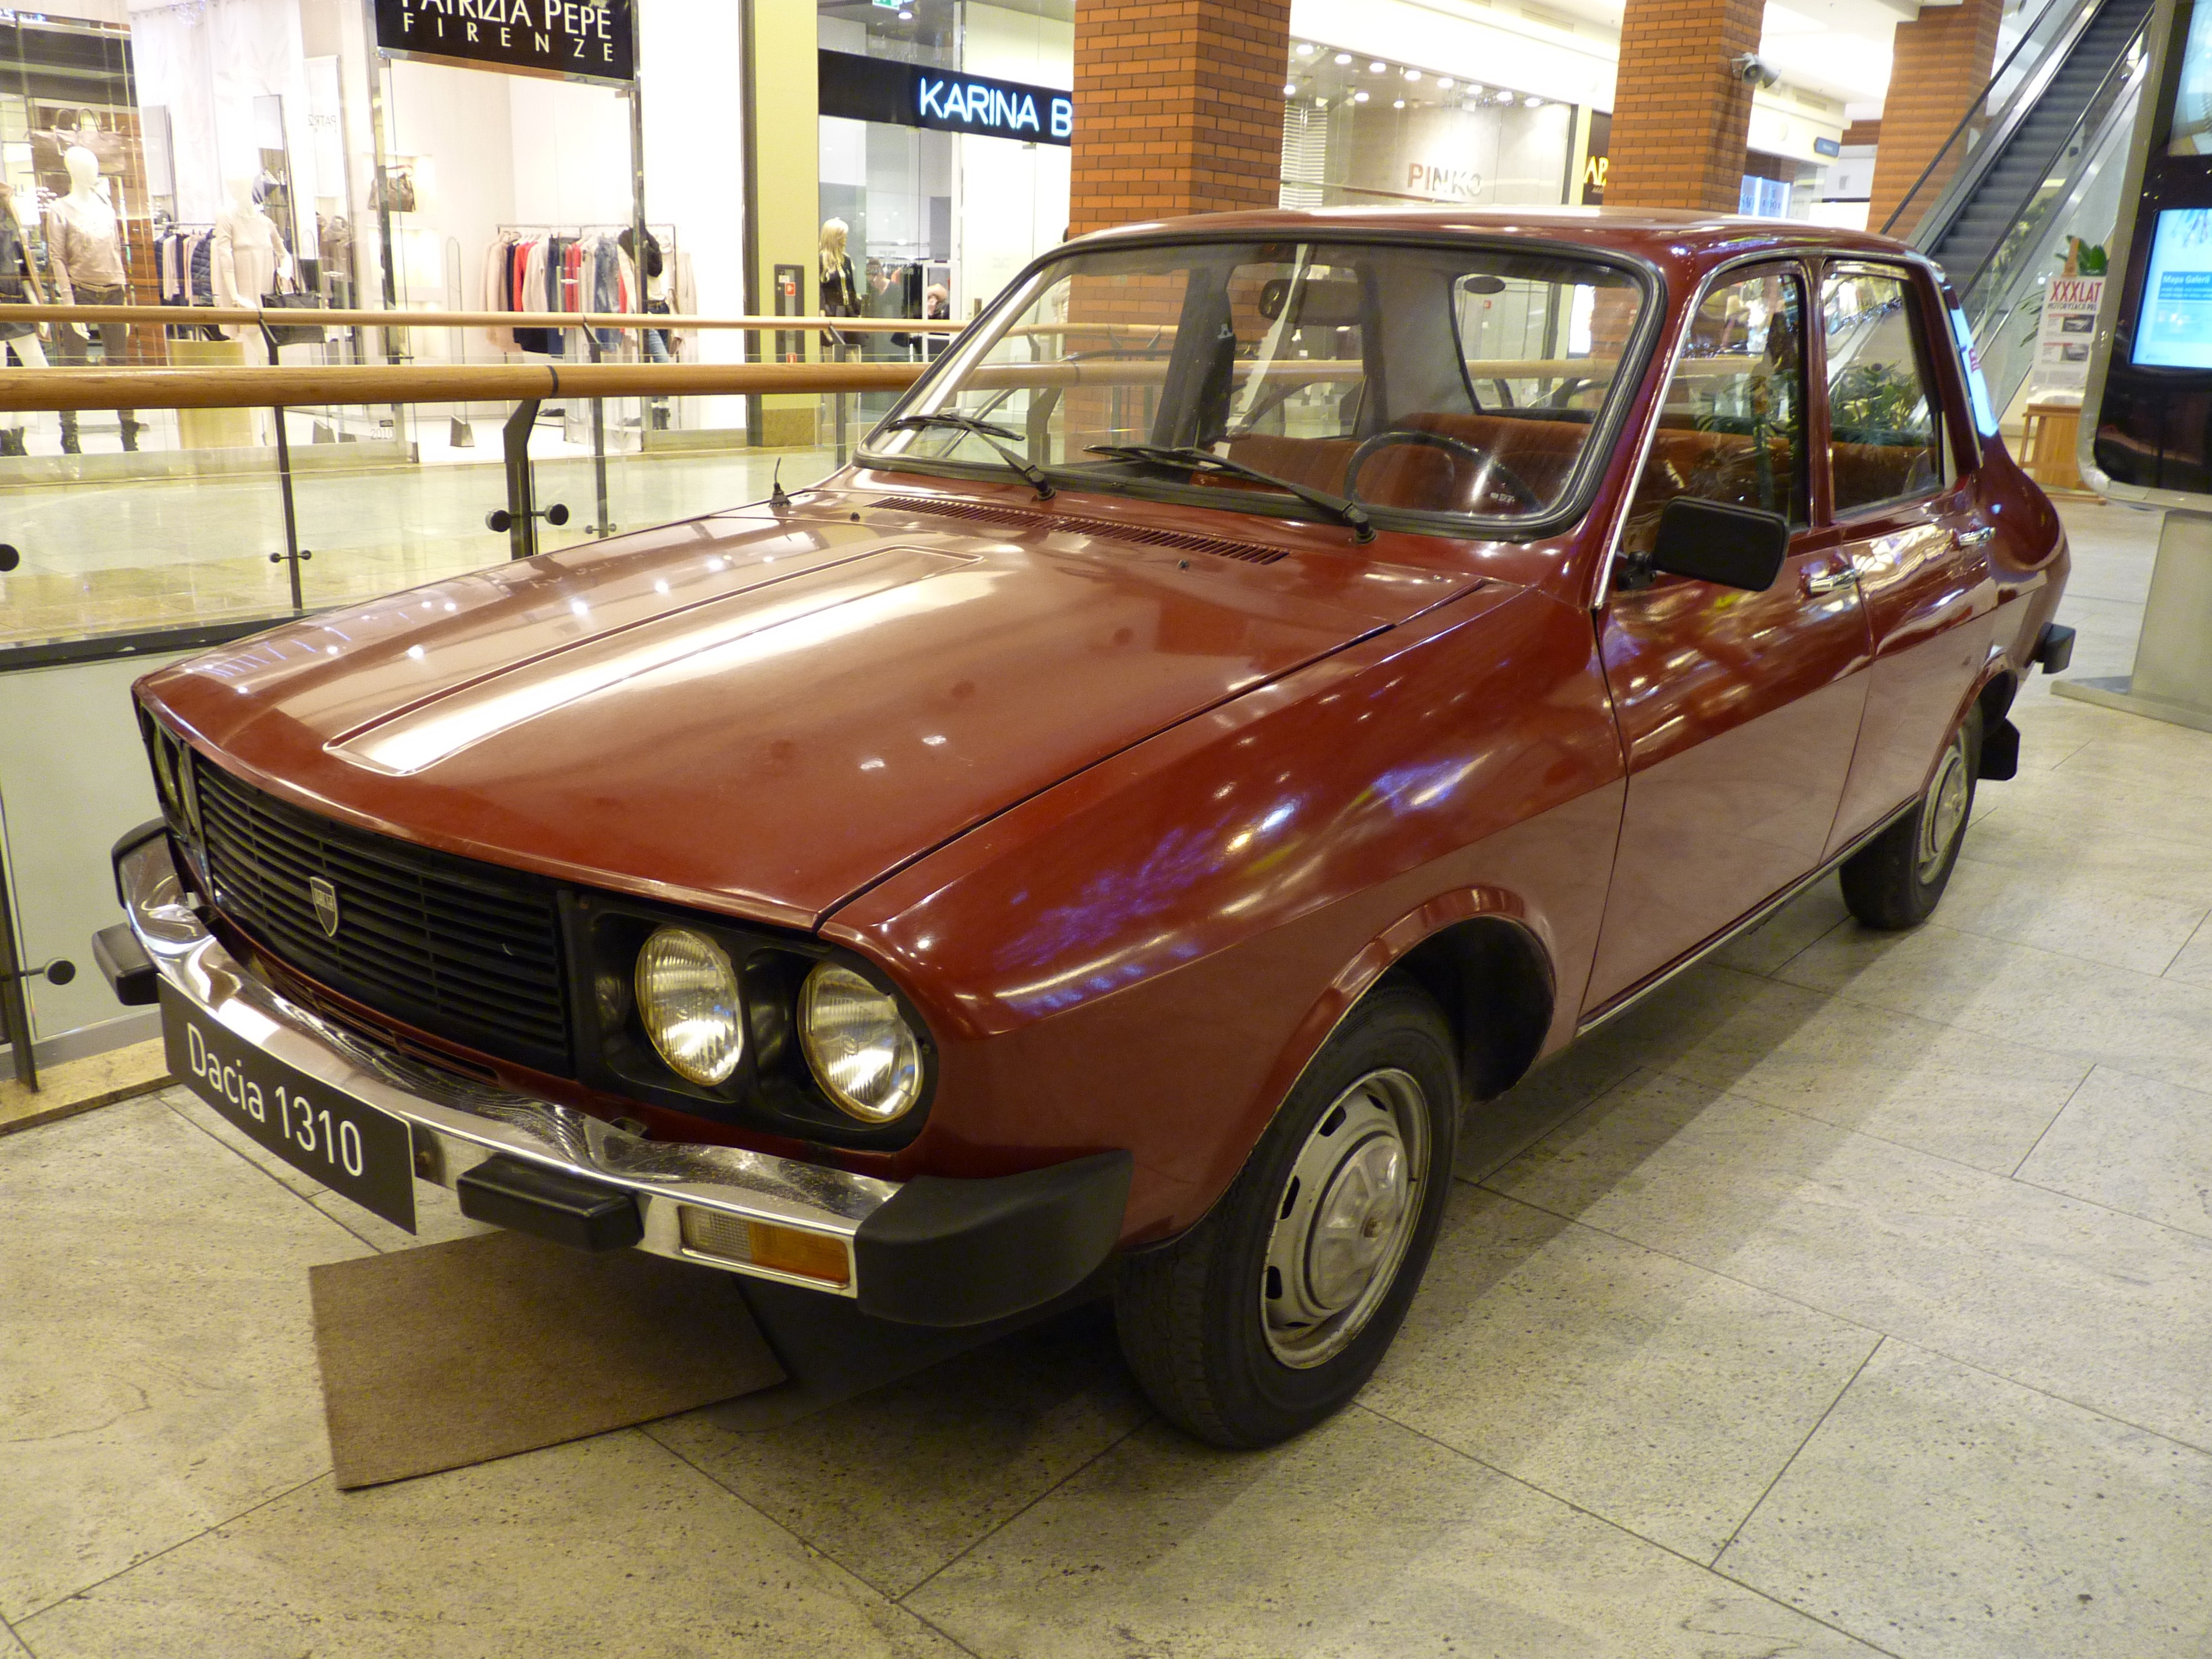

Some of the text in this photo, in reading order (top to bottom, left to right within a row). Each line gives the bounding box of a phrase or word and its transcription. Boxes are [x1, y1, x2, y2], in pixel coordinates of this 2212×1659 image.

[402, 0, 611, 39] RIZIA PEPE
[403, 12, 613, 61] FIRENZE
[921, 77, 1072, 137] KARINA B
[1407, 163, 1483, 196] PINKO
[1583, 155, 1609, 187] AP
[2162, 275, 2184, 285] Mapa
[187, 1022, 362, 1177] Dacia 1310
